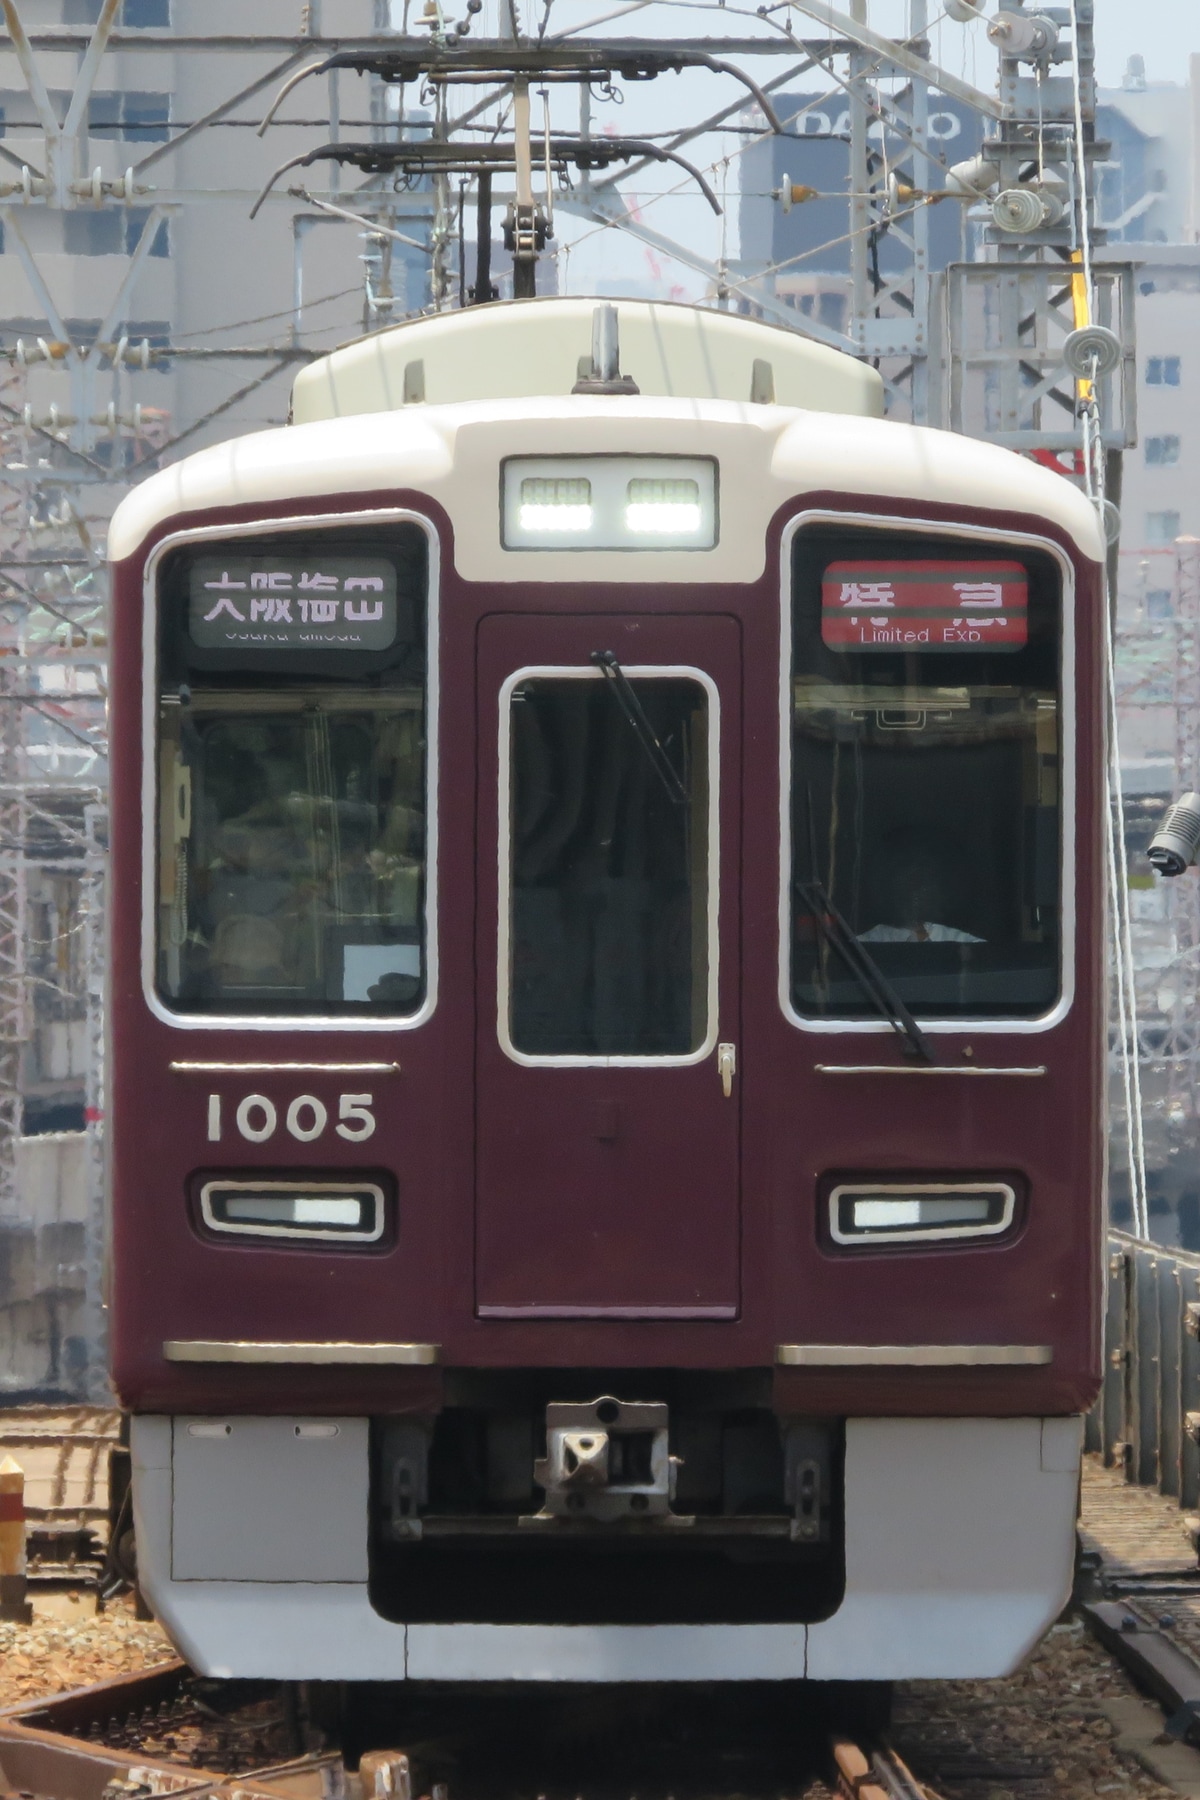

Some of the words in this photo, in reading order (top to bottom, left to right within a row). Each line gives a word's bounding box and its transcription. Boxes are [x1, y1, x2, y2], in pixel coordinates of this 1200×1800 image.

[796, 110, 961, 140] DAO
[204, 571, 384, 623] 大阪梅田
[839, 582, 1008, 627] 特急
[861, 627, 930, 644] Limited
[208, 1094, 376, 1142] 1005
